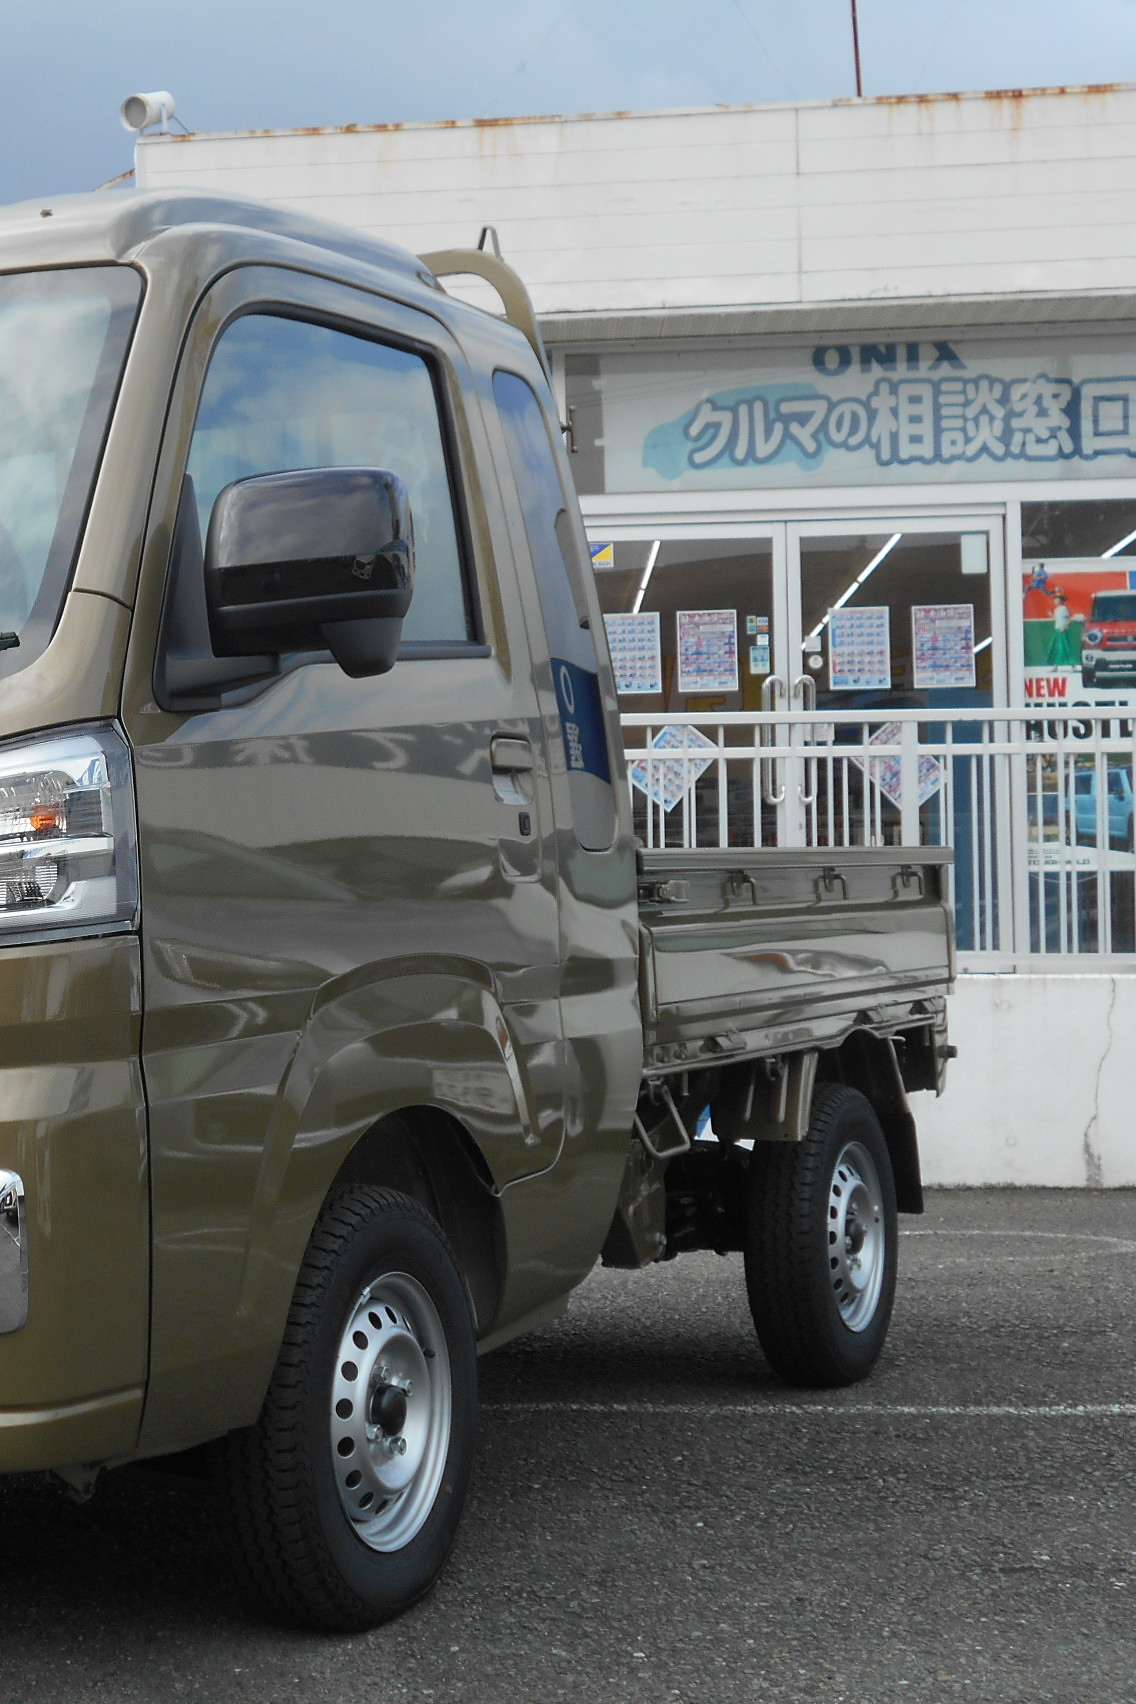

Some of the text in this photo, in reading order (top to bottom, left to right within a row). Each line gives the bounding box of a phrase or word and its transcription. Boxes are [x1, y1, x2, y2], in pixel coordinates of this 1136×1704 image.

[812, 341, 968, 377] ONIX
[684, 375, 1136, 468] クルマの相談窓口
[1024, 677, 1068, 698] NEW
